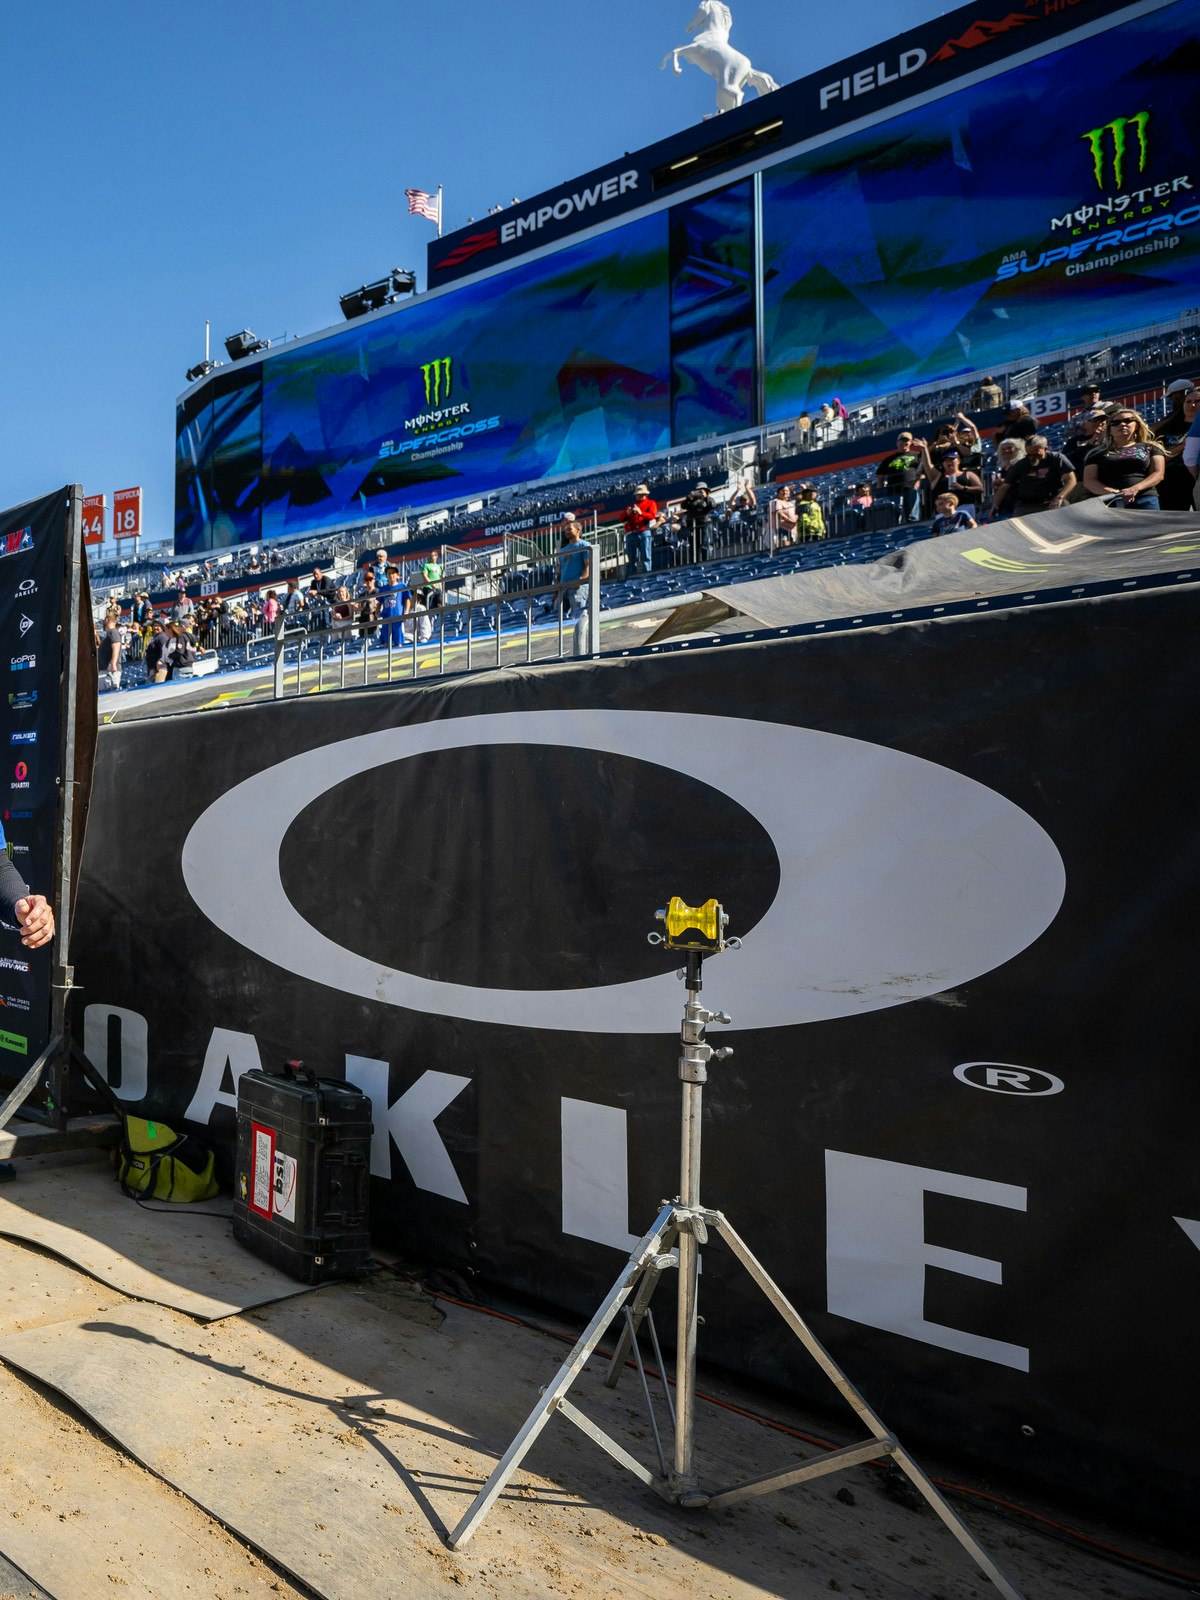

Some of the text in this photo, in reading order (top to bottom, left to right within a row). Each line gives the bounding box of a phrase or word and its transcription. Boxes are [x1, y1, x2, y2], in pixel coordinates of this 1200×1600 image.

[501, 47, 927, 245] EMPOWER FIELD
[1051, 175, 1193, 231] MONSTER
[1072, 200, 1170, 236] ENERGY
[1001, 250, 1028, 265] AMA
[1065, 235, 1180, 277] Championship
[405, 403, 470, 429] MONSTER
[378, 415, 501, 459] SUPERCROSS
[411, 442, 464, 461] Championship
[117, 509, 135, 531] 18
[485, 519, 534, 536] EMPOWER
[15, 587, 39, 598] OAKLEY
[203, 584, 216, 595] 131
[11, 654, 36, 665] GoPro
[12, 732, 36, 741] FALKEN
[83, 1004, 1200, 1373] OAKLE
